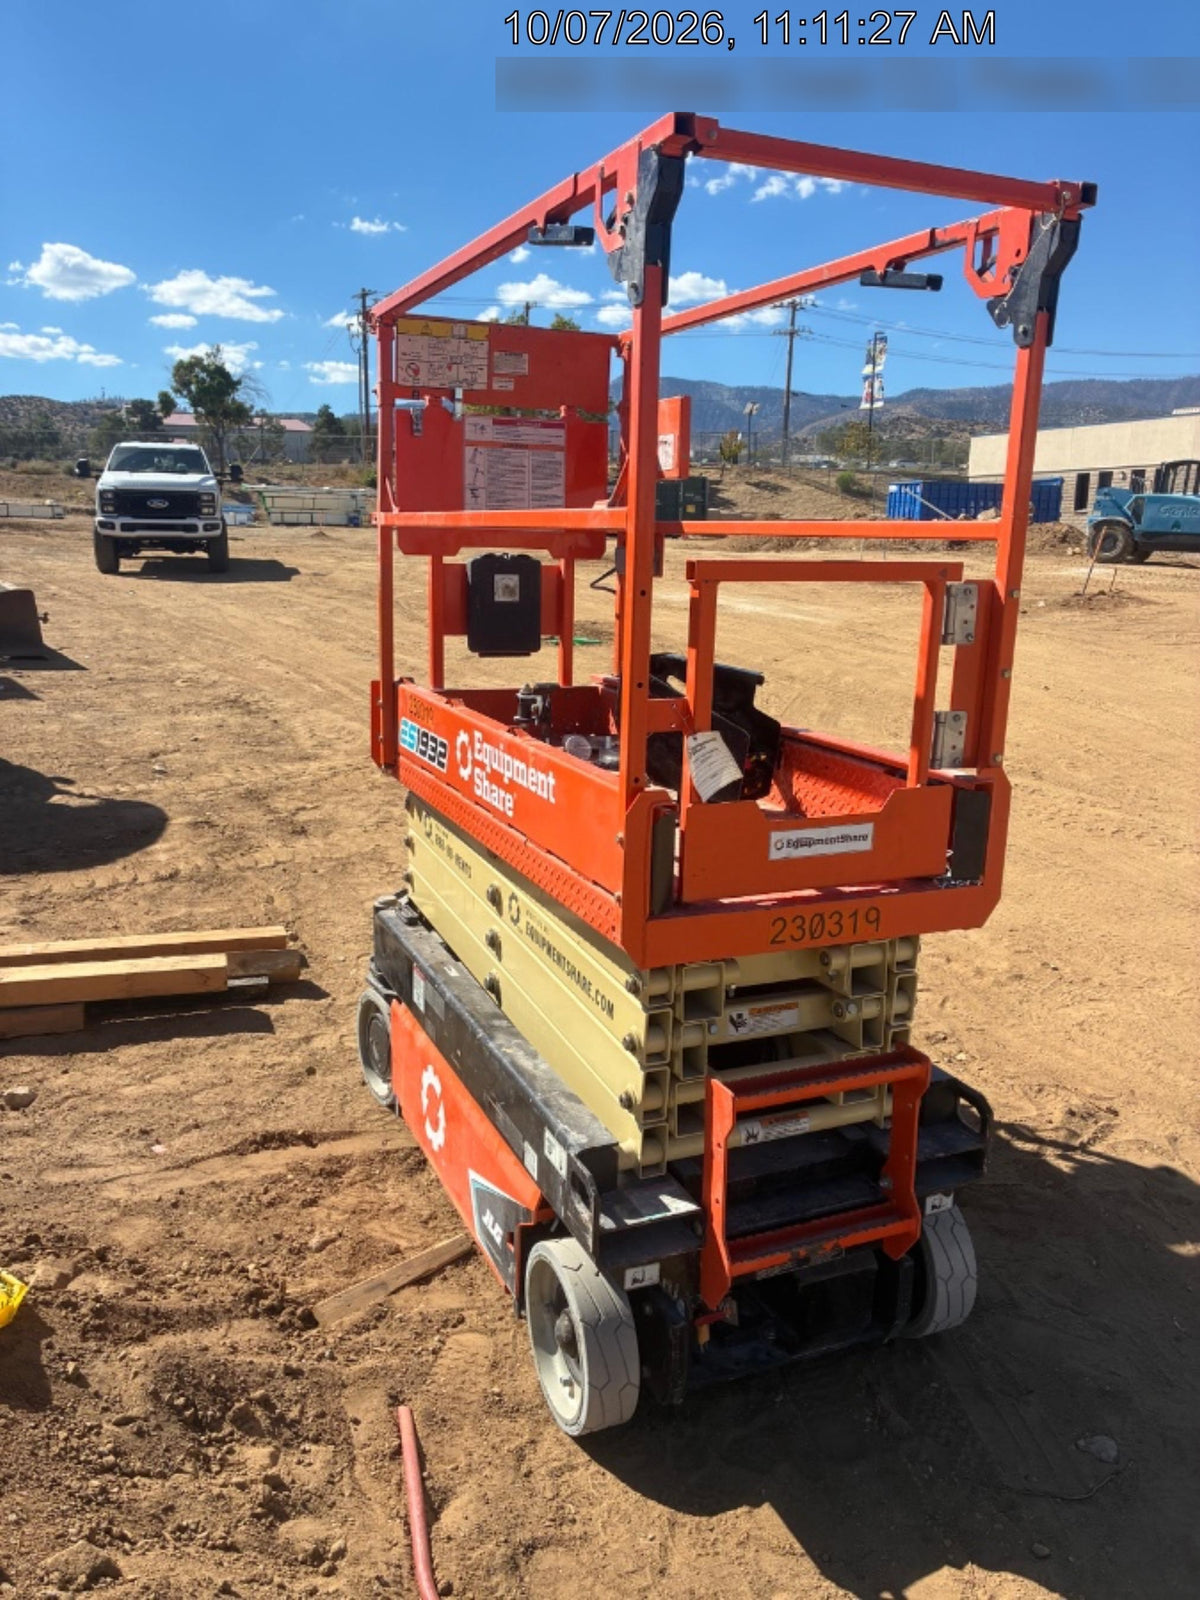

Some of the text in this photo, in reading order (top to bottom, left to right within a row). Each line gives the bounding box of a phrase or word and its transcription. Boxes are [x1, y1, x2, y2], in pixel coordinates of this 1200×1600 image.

[474, 729, 556, 804] Equipment
[474, 767, 514, 818] Share
[785, 832, 869, 850] EquipmentShare
[769, 906, 882, 946] 230319
[525, 921, 614, 1020] EQUIPMENTSHARE.COM
[481, 1207, 504, 1250] JLG
